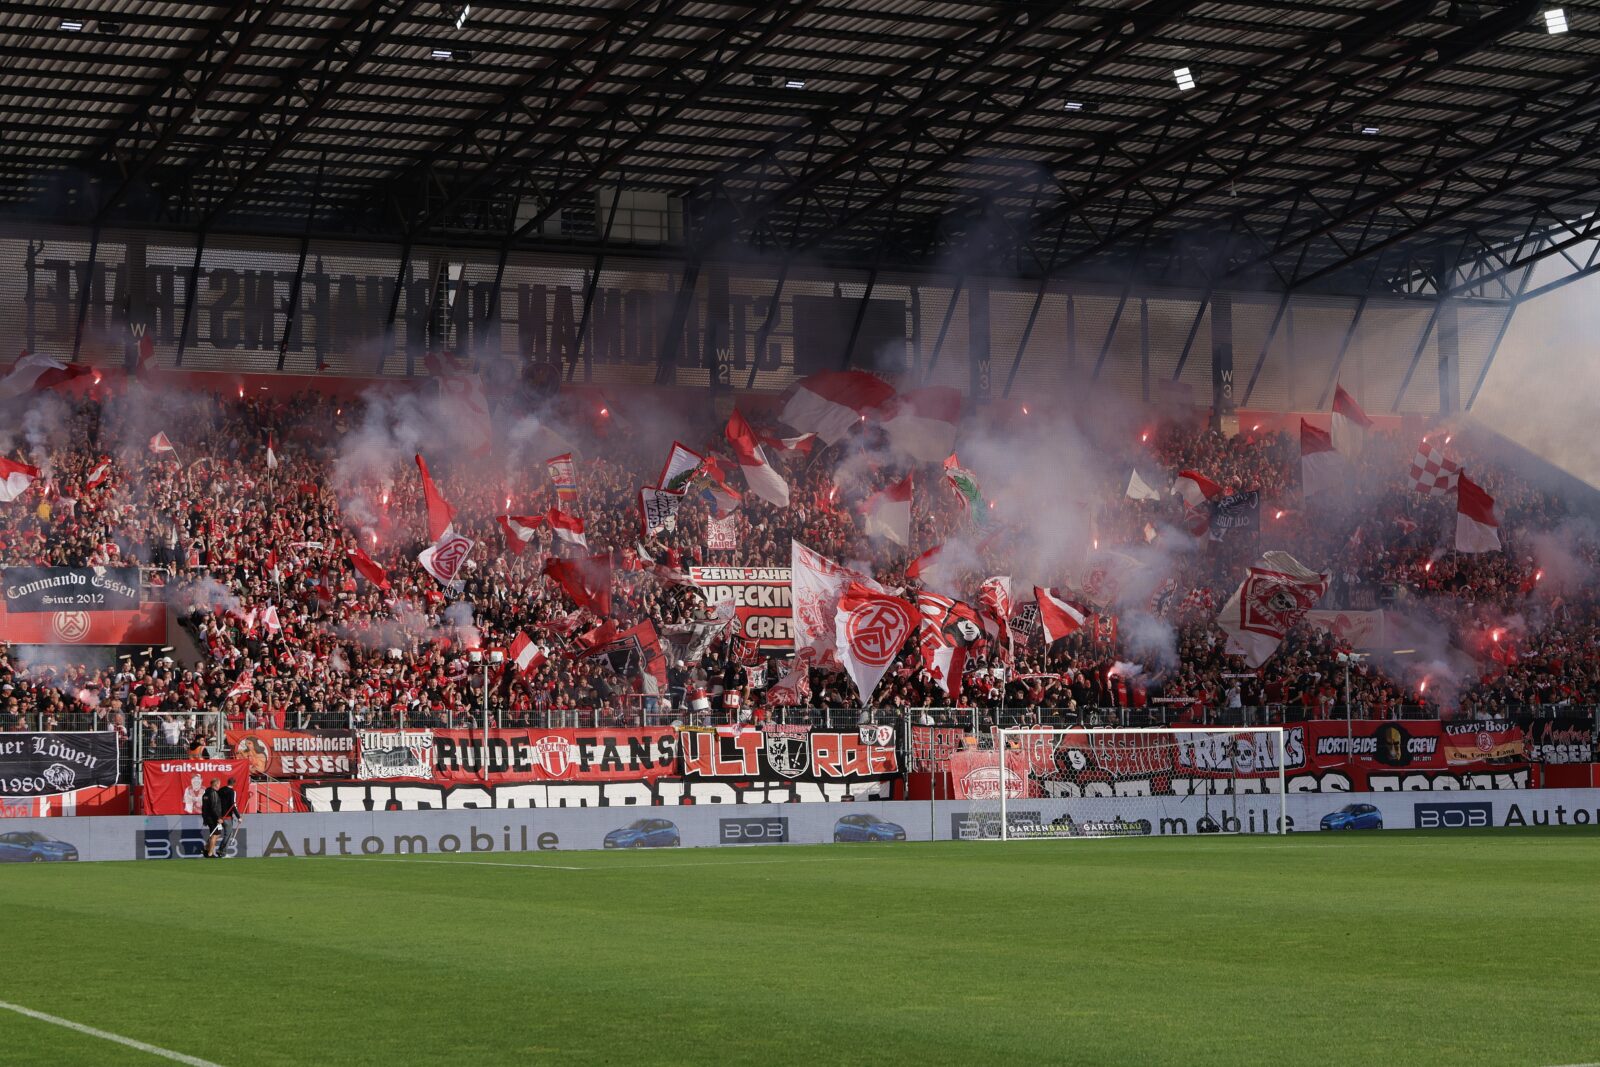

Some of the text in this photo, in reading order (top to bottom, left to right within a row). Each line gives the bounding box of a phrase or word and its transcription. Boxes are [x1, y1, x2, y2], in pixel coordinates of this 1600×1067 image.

[130, 323, 147, 337] W
[716, 348, 730, 362] W
[718, 364, 729, 380] 2
[977, 359, 991, 373] W
[980, 375, 990, 390] 3
[1221, 369, 1233, 382] W
[1223, 385, 1232, 399] 3
[701, 569, 791, 580] ZEHN JAHR
[7, 572, 136, 599] Commando Essen
[42, 594, 105, 605] Since 2012
[745, 616, 794, 639] CRE
[273, 734, 353, 752] HAFENSÄNGER
[1406, 737, 1437, 754] CREW
[0, 736, 98, 769] er Löwen
[433, 734, 677, 775] RUDE FANS
[1531, 743, 1592, 765] ESSEN
[161, 763, 233, 773] Uralt-Ultras
[1, 776, 45, 792] 1980
[1420, 804, 1600, 828] BOB Auto
[724, 823, 784, 838] BOB
[1008, 824, 1069, 832] GARTENBAU
[1083, 823, 1141, 831] GARTENBAU
[263, 825, 560, 857] Automobile
